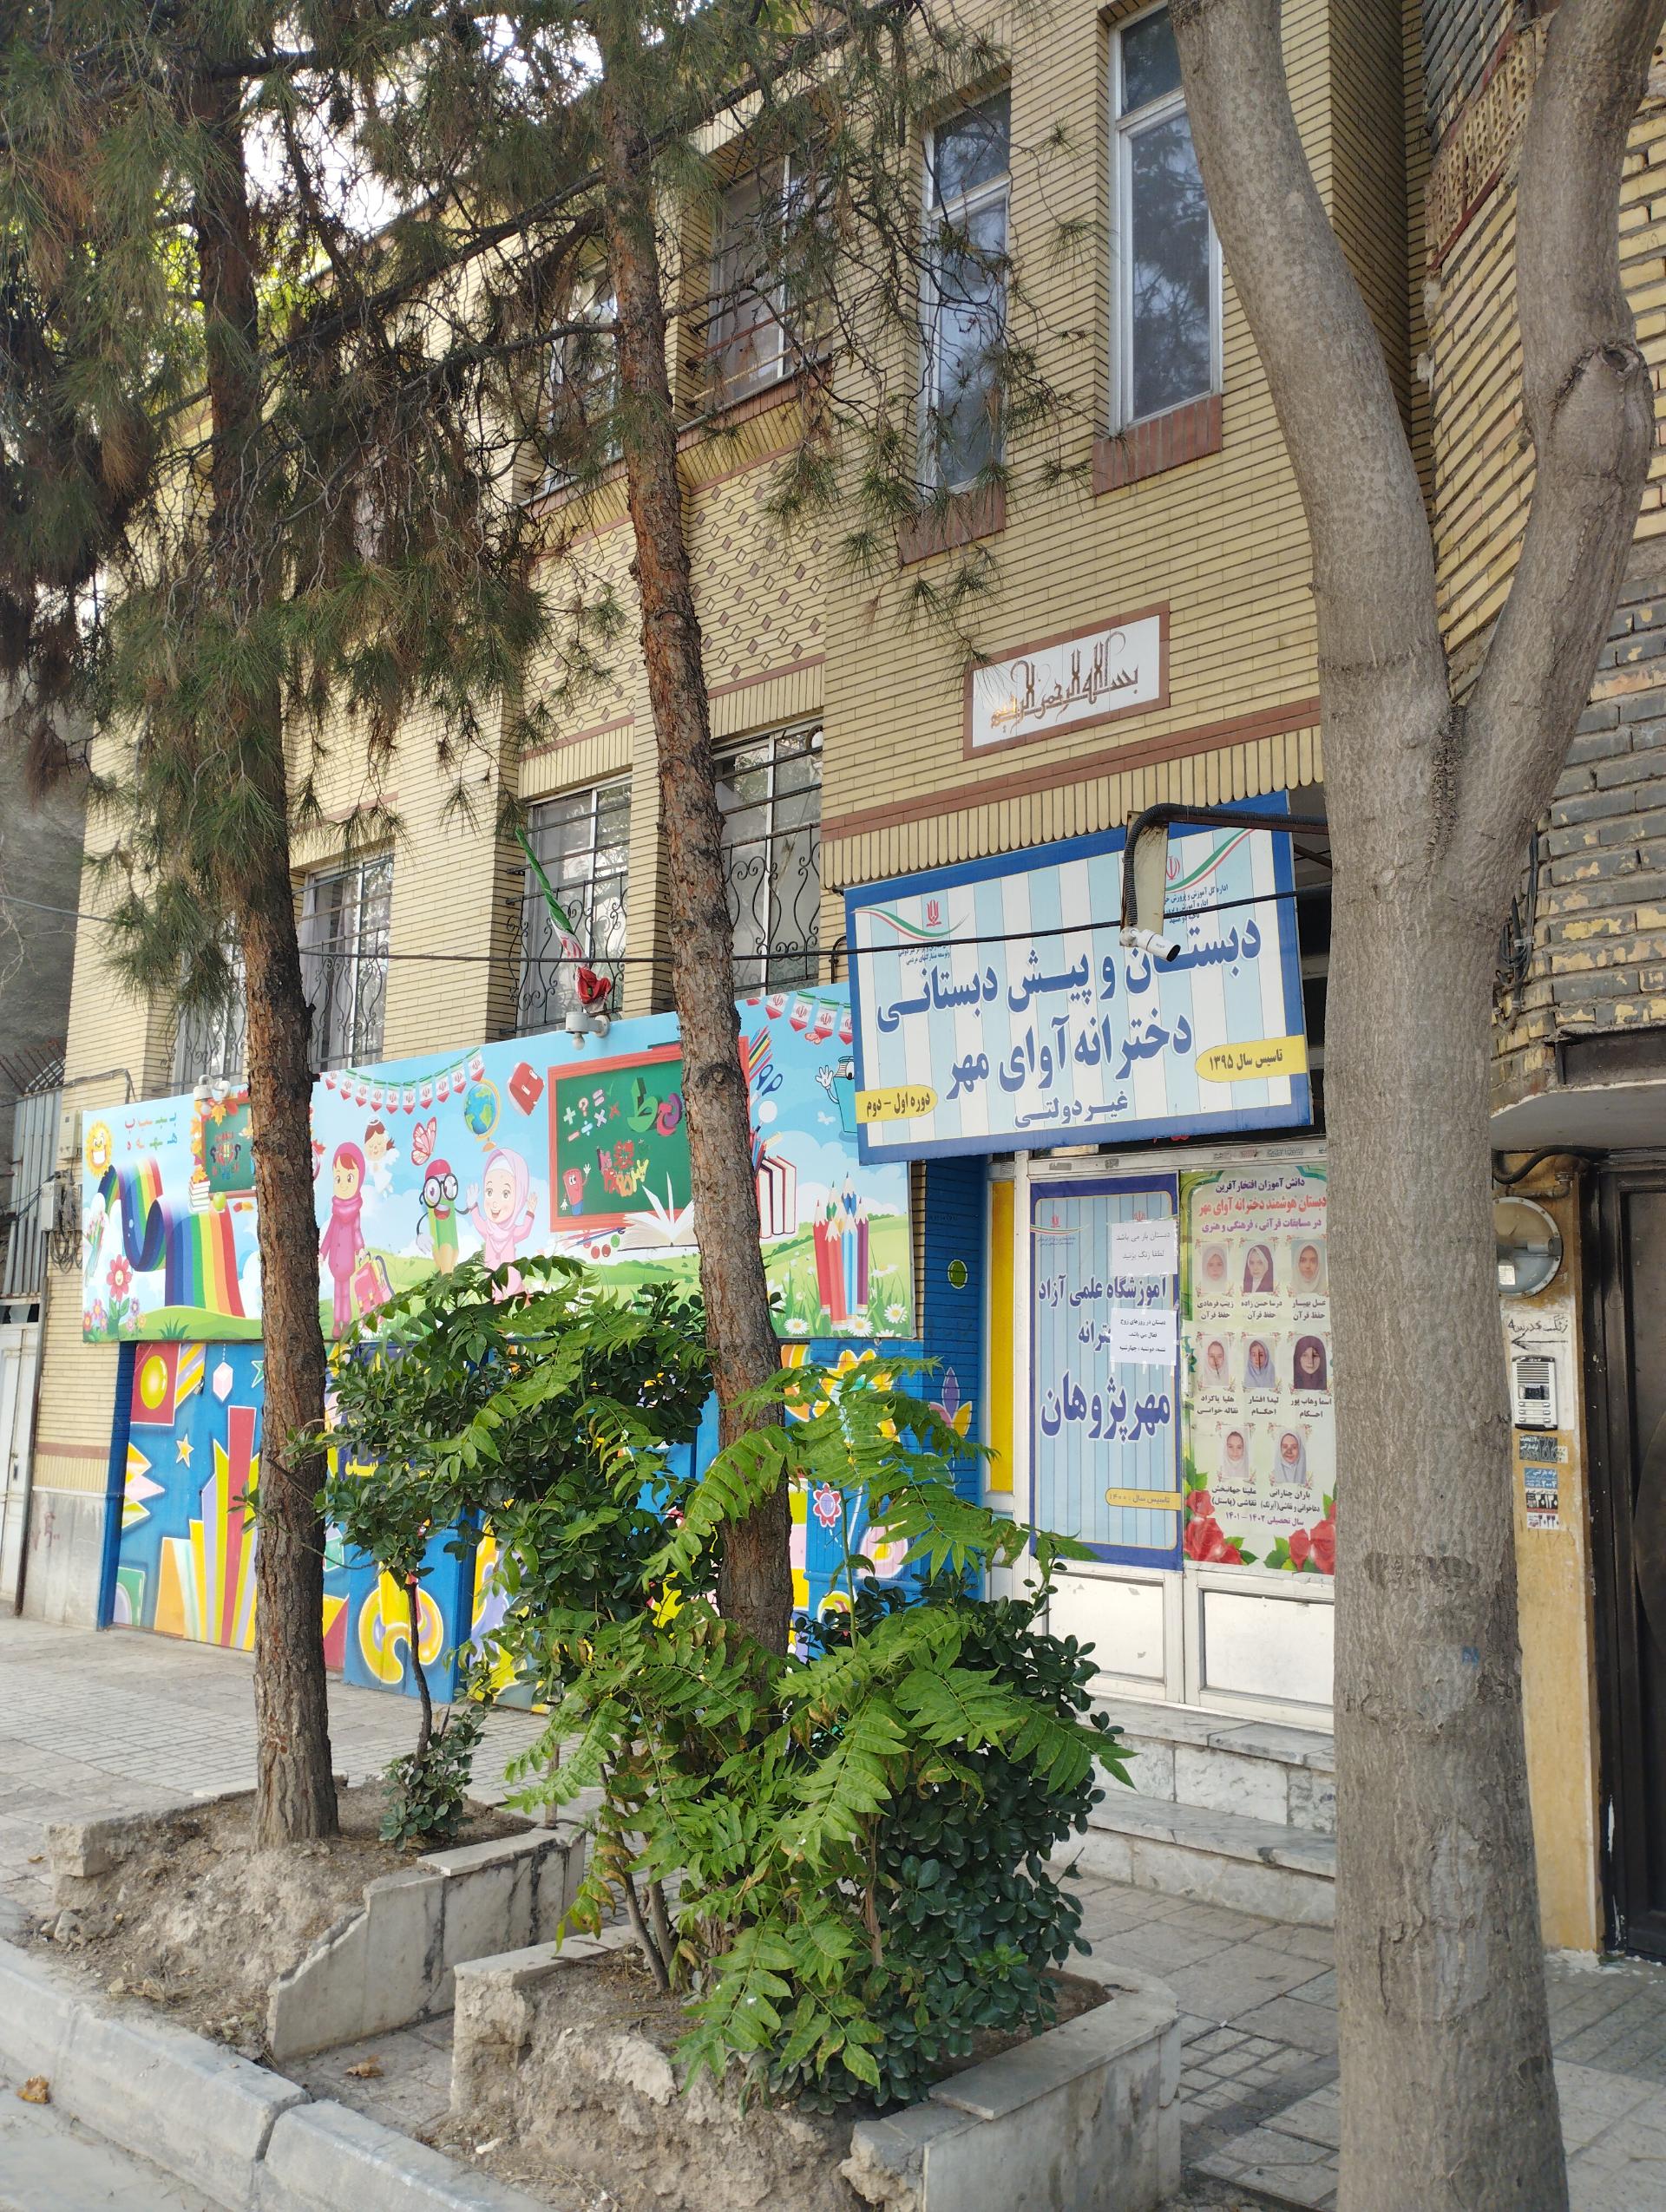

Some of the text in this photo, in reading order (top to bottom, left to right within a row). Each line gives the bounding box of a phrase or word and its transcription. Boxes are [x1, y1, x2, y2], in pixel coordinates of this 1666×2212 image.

[1007, 949, 1092, 1013] پیش
[1100, 955, 1116, 1000] و
[877, 965, 998, 1032] دبستانی
[946, 1007, 1192, 1100] دخترانه آوای مهر
[1210, 1049, 1283, 1071] تاسیس سال ۱۳۹۵
[866, 1098, 882, 1117] دوم
[894, 1091, 908, 1115] اول
[911, 1092, 930, 1112] دوره
[1215, 1178, 1305, 1193] دانش آموزان افتخار آفرین
[1199, 1194, 1327, 1216] دبستان هوشمند دخترانه آوای مهر
[1202, 1222, 1220, 1233] هنری
[1226, 1220, 1254, 1232] فرهنگی
[1282, 1218, 1311, 1229] مسابقات
[1313, 1219, 1322, 1229] در
[1038, 1274, 1066, 1307] آزاد
[1069, 1277, 1103, 1306] علمی
[1201, 1310, 1217, 1320] قرآن
[1247, 1310, 1262, 1320] قرآن
[1293, 1311, 1309, 1321] قرآن
[1543, 1314, 1568, 1333] زنگ
[1078, 1319, 1111, 1351] ترانه
